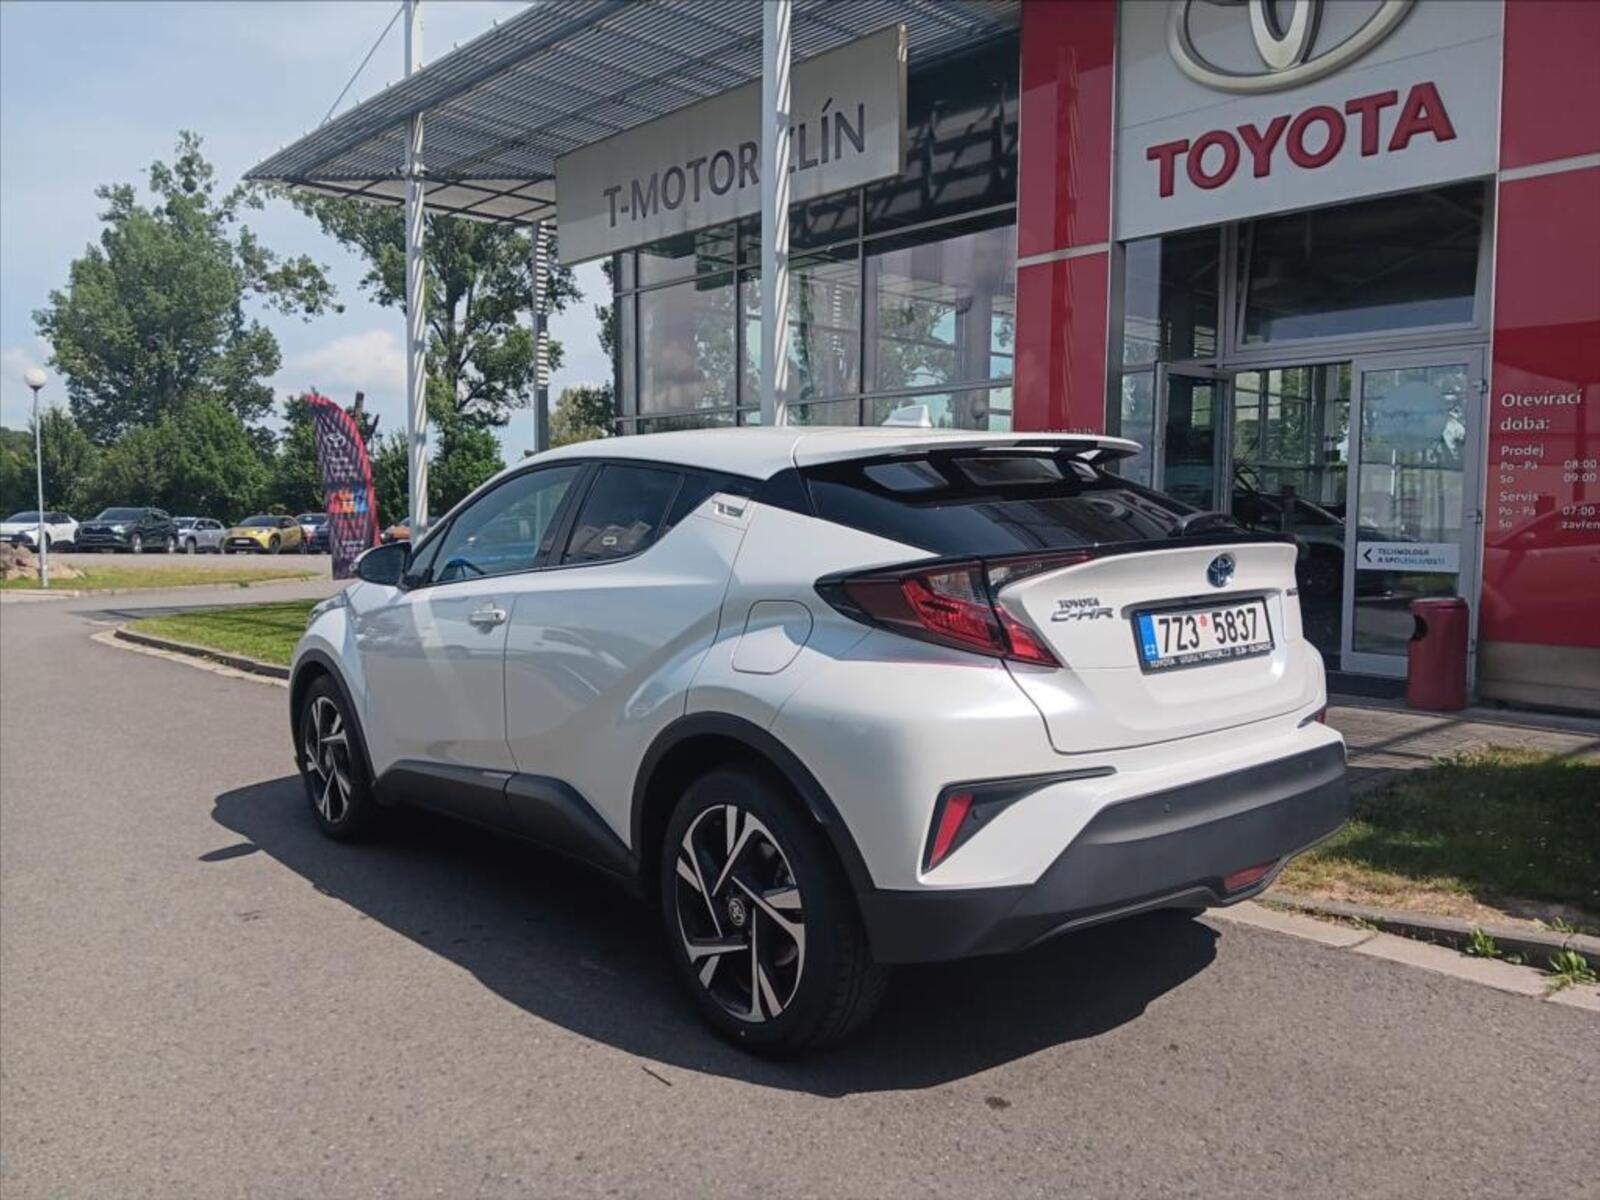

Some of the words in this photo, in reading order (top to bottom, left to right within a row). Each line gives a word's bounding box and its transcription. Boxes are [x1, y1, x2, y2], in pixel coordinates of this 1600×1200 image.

[1147, 82, 1456, 198] TOYOTA
[603, 140, 760, 228] T-MOTOR
[1500, 416, 1550, 431] doba:
[1501, 444, 1544, 458] Prodej
[1500, 491, 1539, 502] Servis
[1058, 597, 1100, 609] TOYOTA
[1051, 607, 1114, 622] C-HR
[1158, 615, 1200, 653] 7Z3
[1211, 607, 1257, 644] 5837
